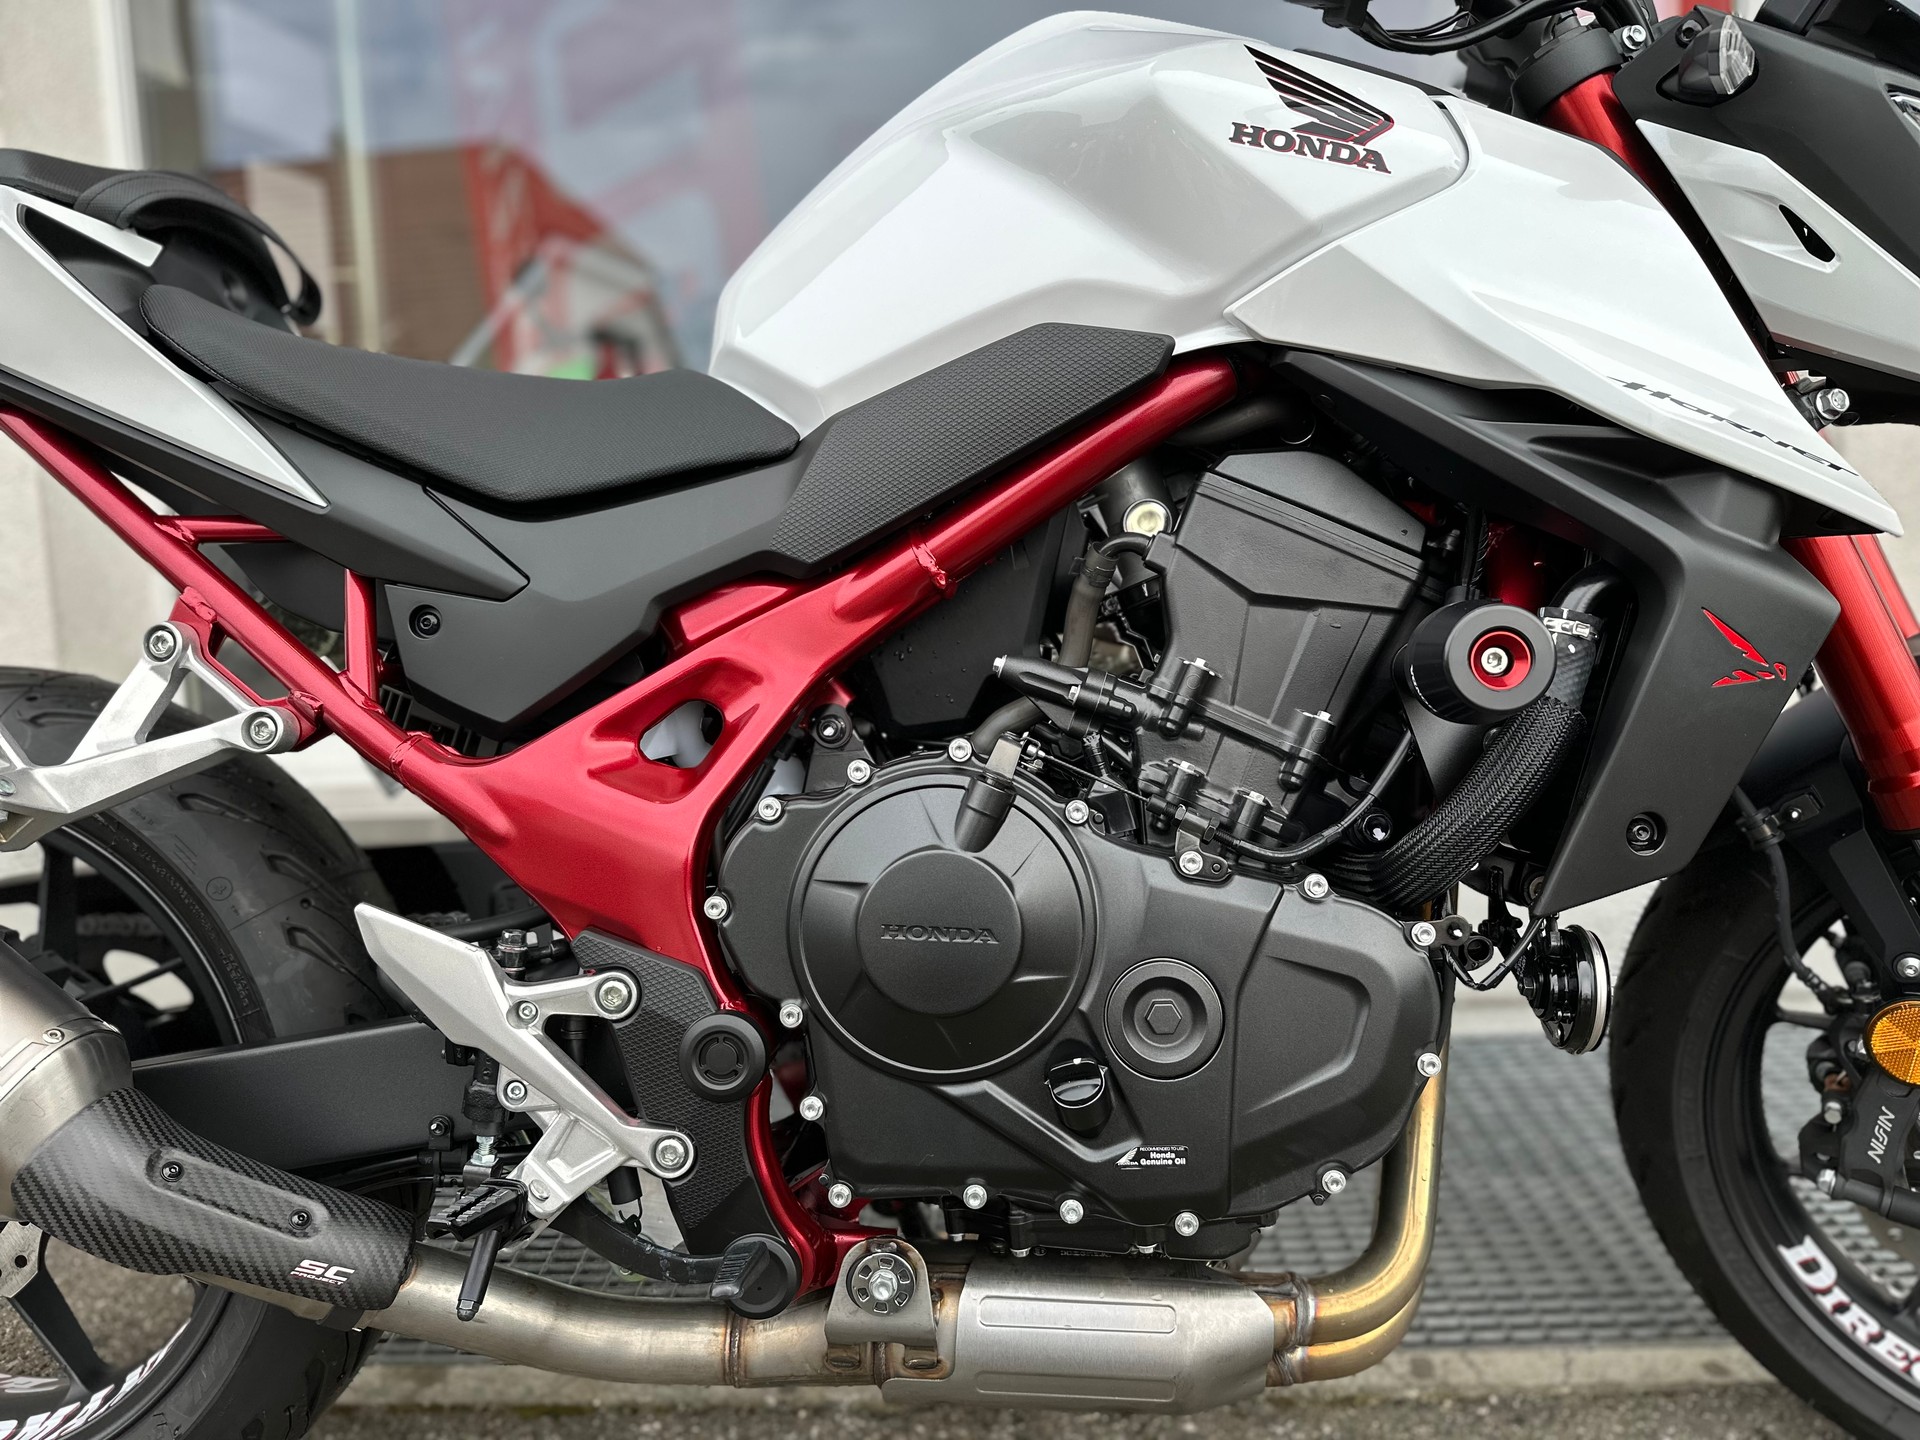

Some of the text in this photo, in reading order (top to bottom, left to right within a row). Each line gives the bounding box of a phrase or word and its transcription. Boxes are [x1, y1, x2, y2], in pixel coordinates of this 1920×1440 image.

[1229, 122, 1391, 174] HONDA
[880, 923, 999, 944] HONDA
[1150, 1151, 1175, 1159] Honda
[1174, 1157, 1186, 1165] Oil
[290, 1271, 343, 1286] PROJECT
[294, 1259, 355, 1282] SC
